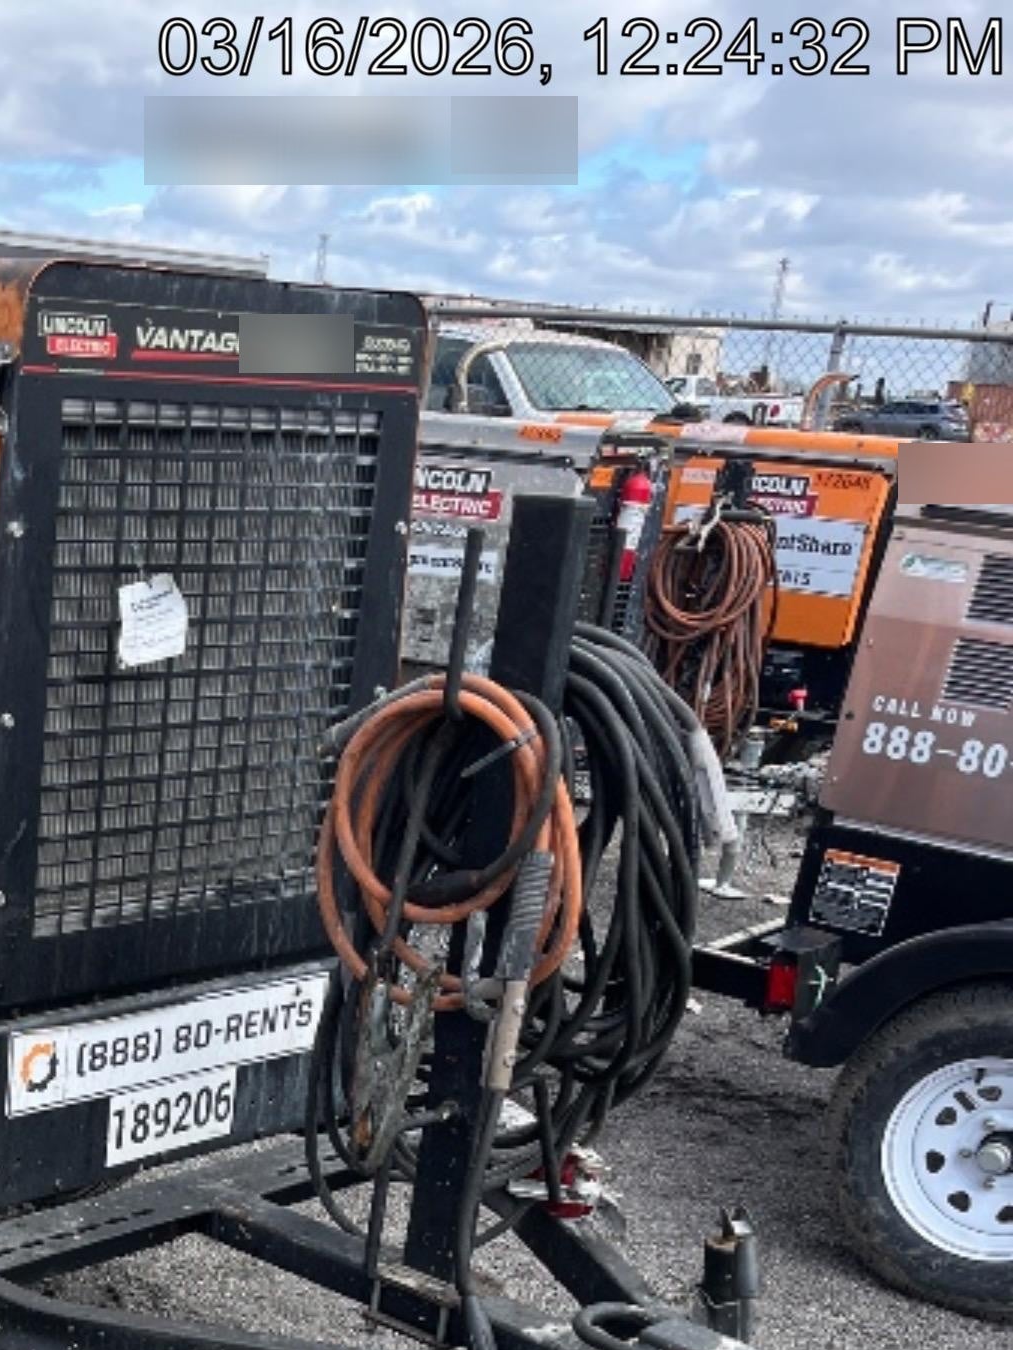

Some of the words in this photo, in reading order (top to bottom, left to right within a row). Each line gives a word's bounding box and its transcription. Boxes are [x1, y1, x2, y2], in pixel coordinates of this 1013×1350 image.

[43, 316, 106, 337] LINCOLN
[136, 326, 239, 353] VANTAG
[54, 337, 111, 355] ELECTRIC
[415, 466, 486, 493] NCOLN
[776, 534, 853, 556] ntShare
[872, 695, 922, 719] CALL
[930, 705, 978, 728] NOW
[862, 721, 1013, 778] 888-80
[76, 1027, 163, 1078] (888)
[173, 998, 314, 1055] 80-RENTS
[111, 1081, 232, 1150] 189206
